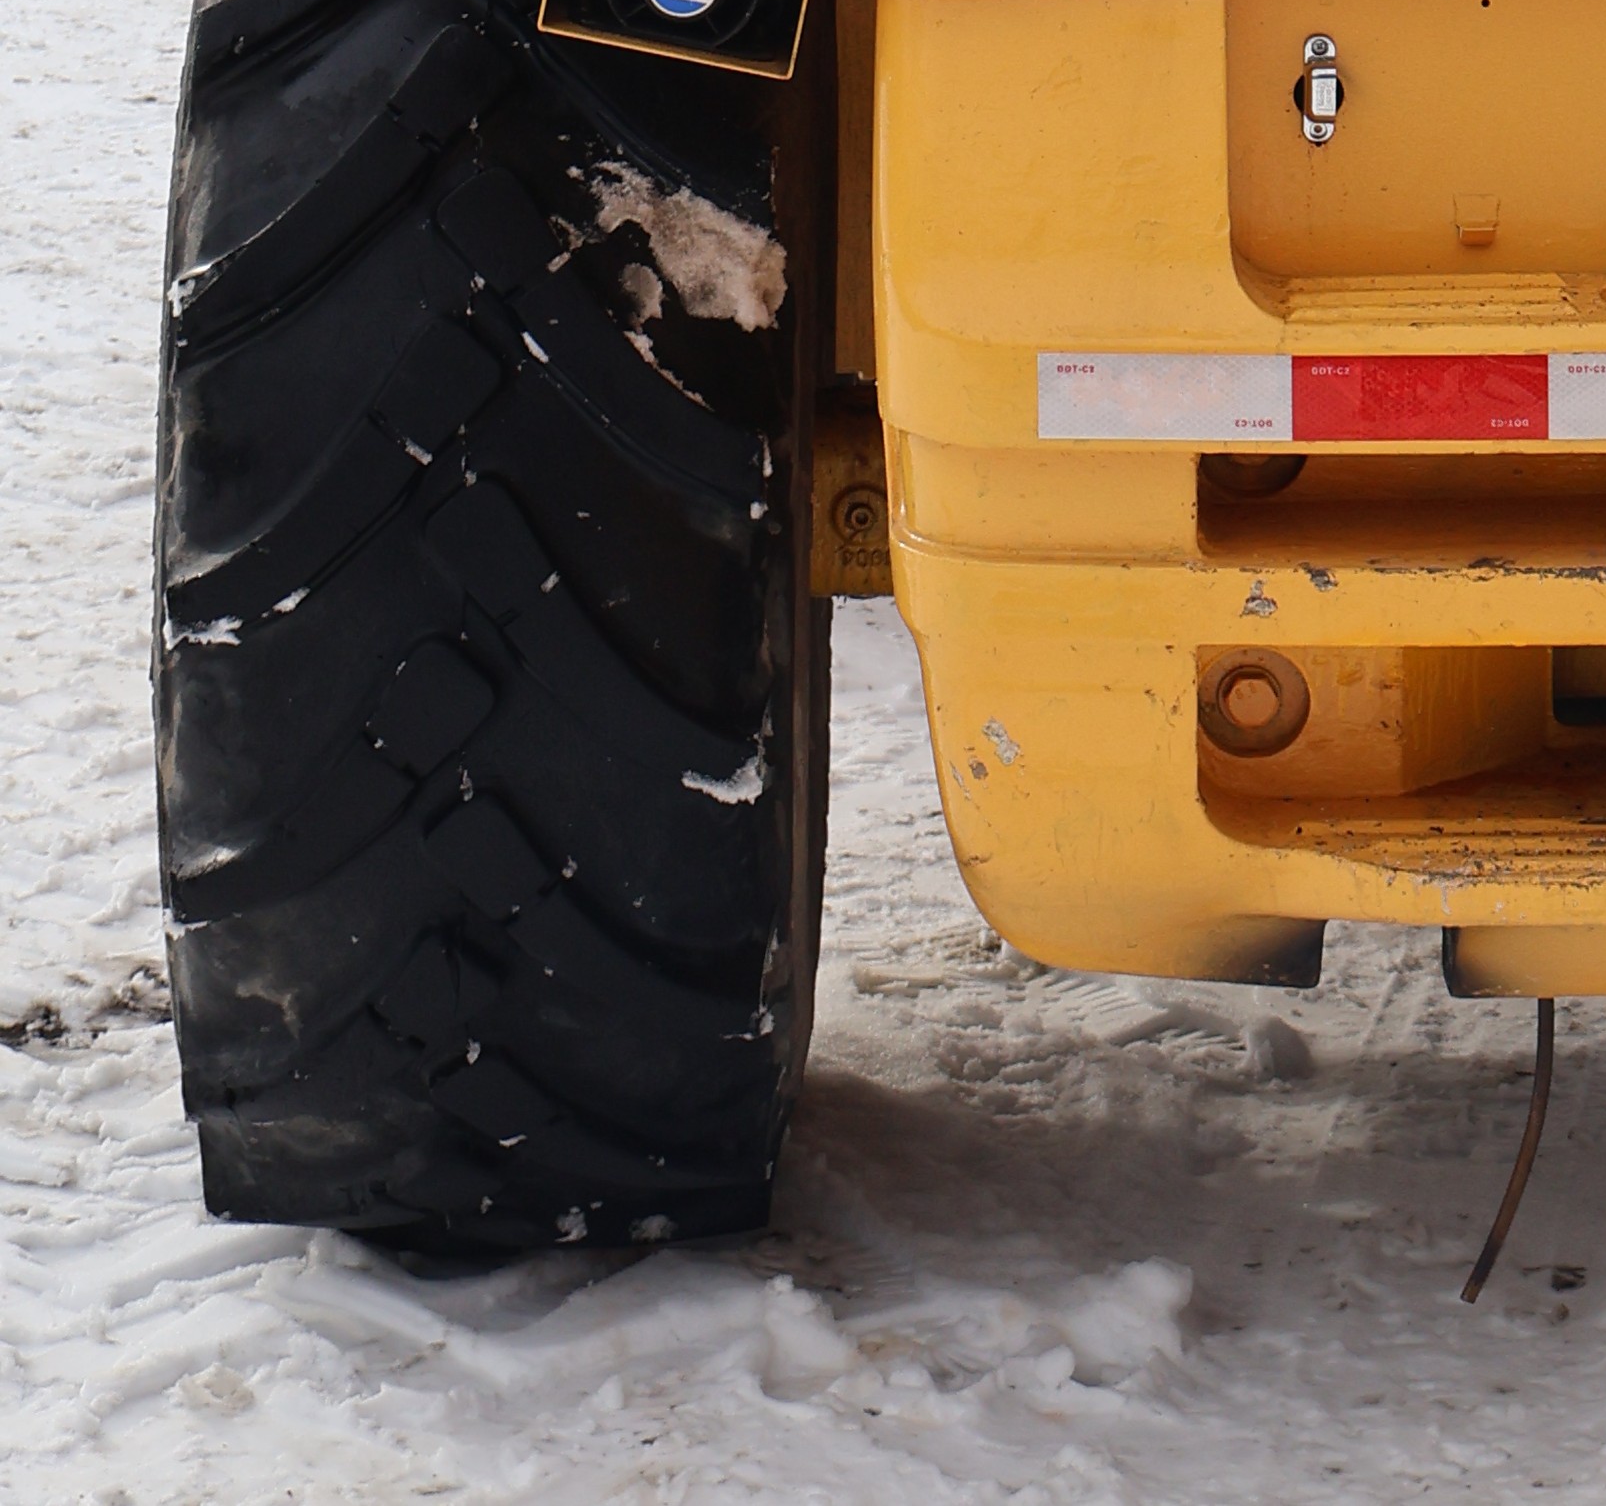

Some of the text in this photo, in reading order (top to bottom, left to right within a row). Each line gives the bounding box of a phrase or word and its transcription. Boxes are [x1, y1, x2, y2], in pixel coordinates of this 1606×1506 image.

[1056, 364, 1095, 374] DOT-C2
[1311, 366, 1350, 376] DOT-C2
[1567, 364, 1606, 374] DOT-C2
